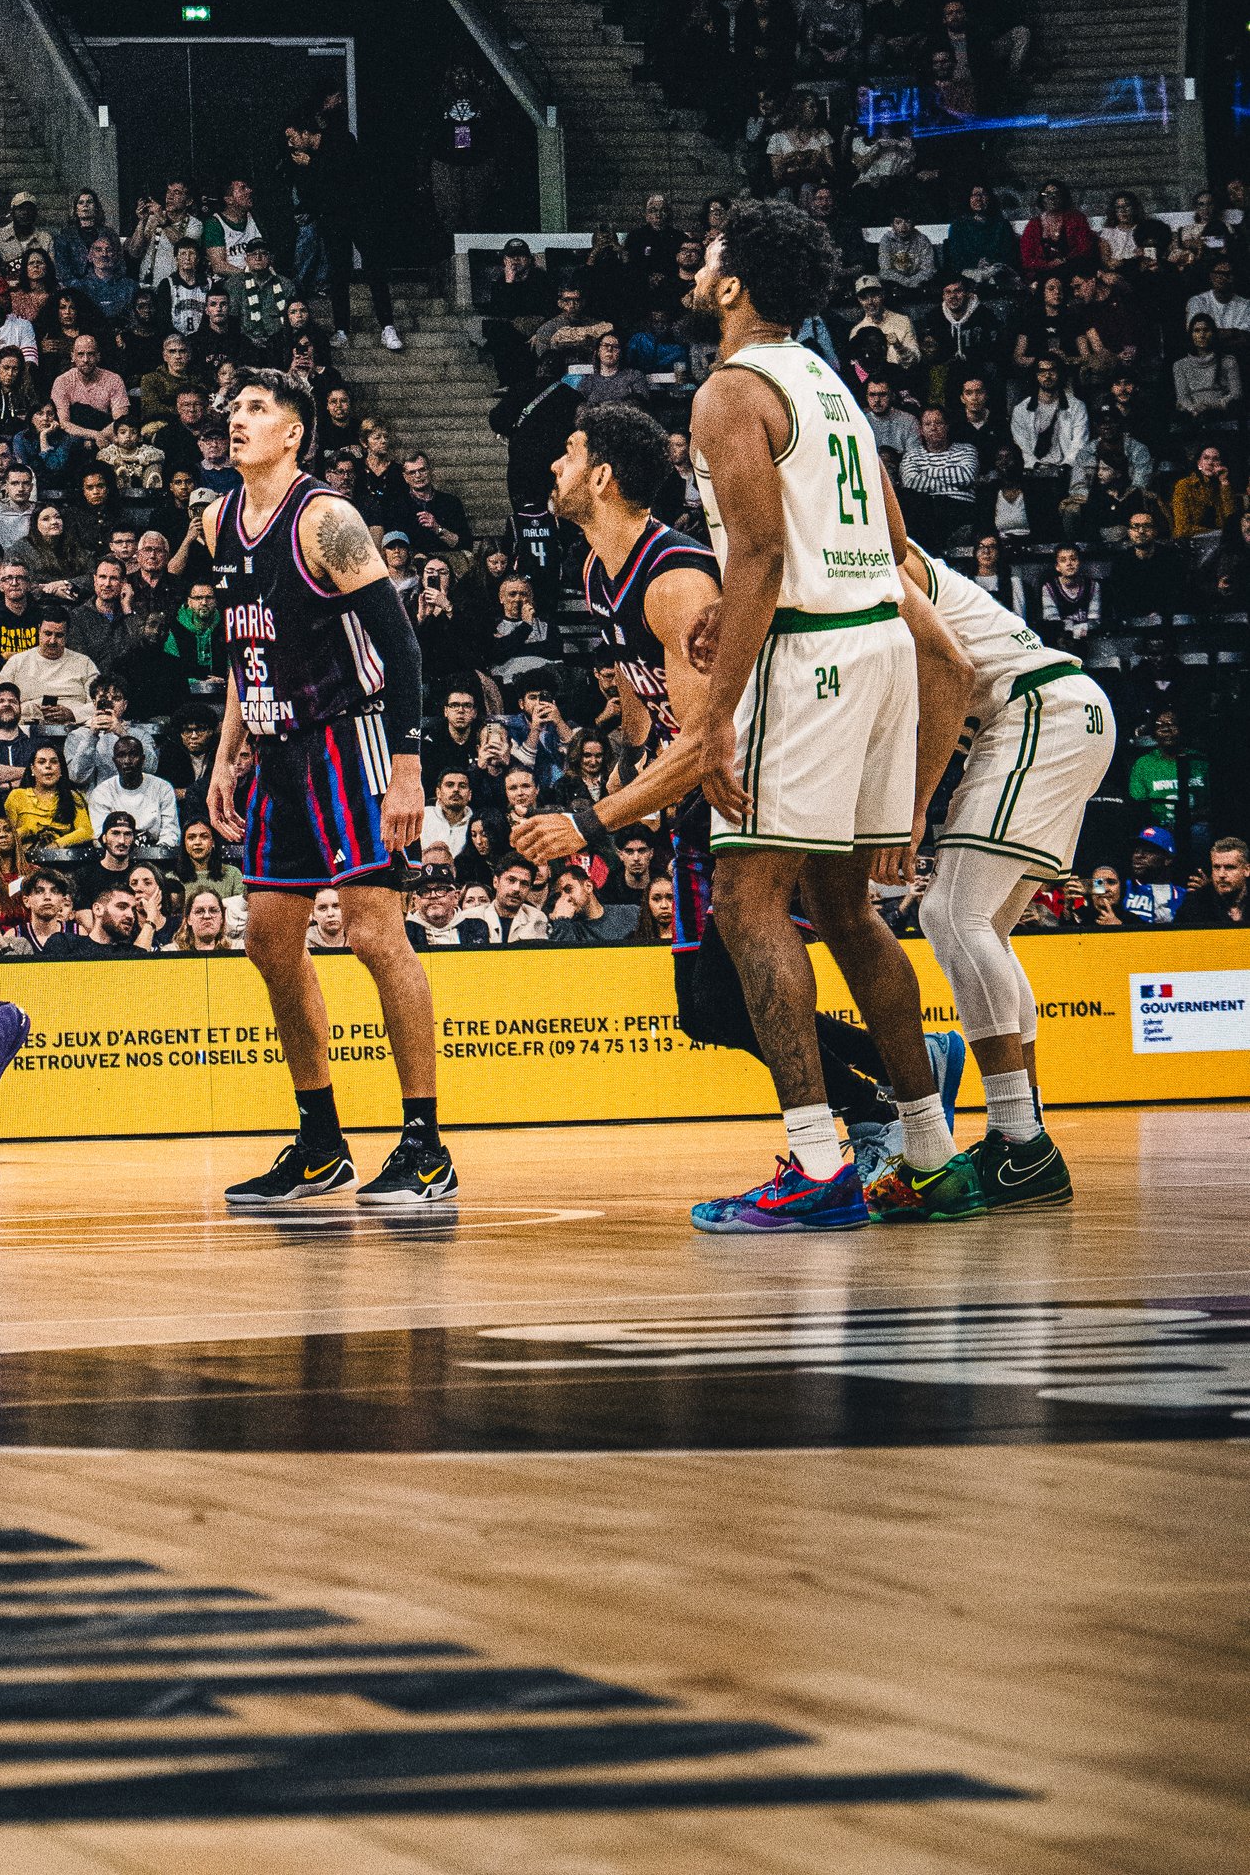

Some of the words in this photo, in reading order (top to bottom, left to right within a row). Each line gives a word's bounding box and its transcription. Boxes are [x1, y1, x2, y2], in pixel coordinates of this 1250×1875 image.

[816, 391, 850, 422] SCOTT
[828, 433, 869, 525] 24
[530, 542, 546, 566] 4
[225, 594, 276, 643] PARIS
[243, 647, 268, 682] 35
[814, 665, 841, 700] 24
[1085, 704, 1104, 735] 30
[1140, 999, 1246, 1014] GOUVERNEMENT
[21, 1032, 47, 1049] ES
[52, 1031, 101, 1048] JEUX
[107, 1027, 202, 1046] D'ARGENT
[207, 1027, 231, 1043] ET
[236, 1027, 260, 1042] DE
[443, 1017, 490, 1037] ÊTRE
[495, 1017, 609, 1035] DANGEREUX
[920, 1007, 959, 1022] MILI
[13, 1052, 121, 1071] RETROUVEZ
[126, 1051, 163, 1067] NOS
[168, 1049, 258, 1066] CONSEILS
[436, 1040, 544, 1058] -SERVICE.FR
[549, 1040, 575, 1058] (09
[580, 1039, 600, 1054] 74
[605, 1039, 624, 1053] 75
[630, 1038, 648, 1053] 13
[654, 1037, 673, 1052] 13
